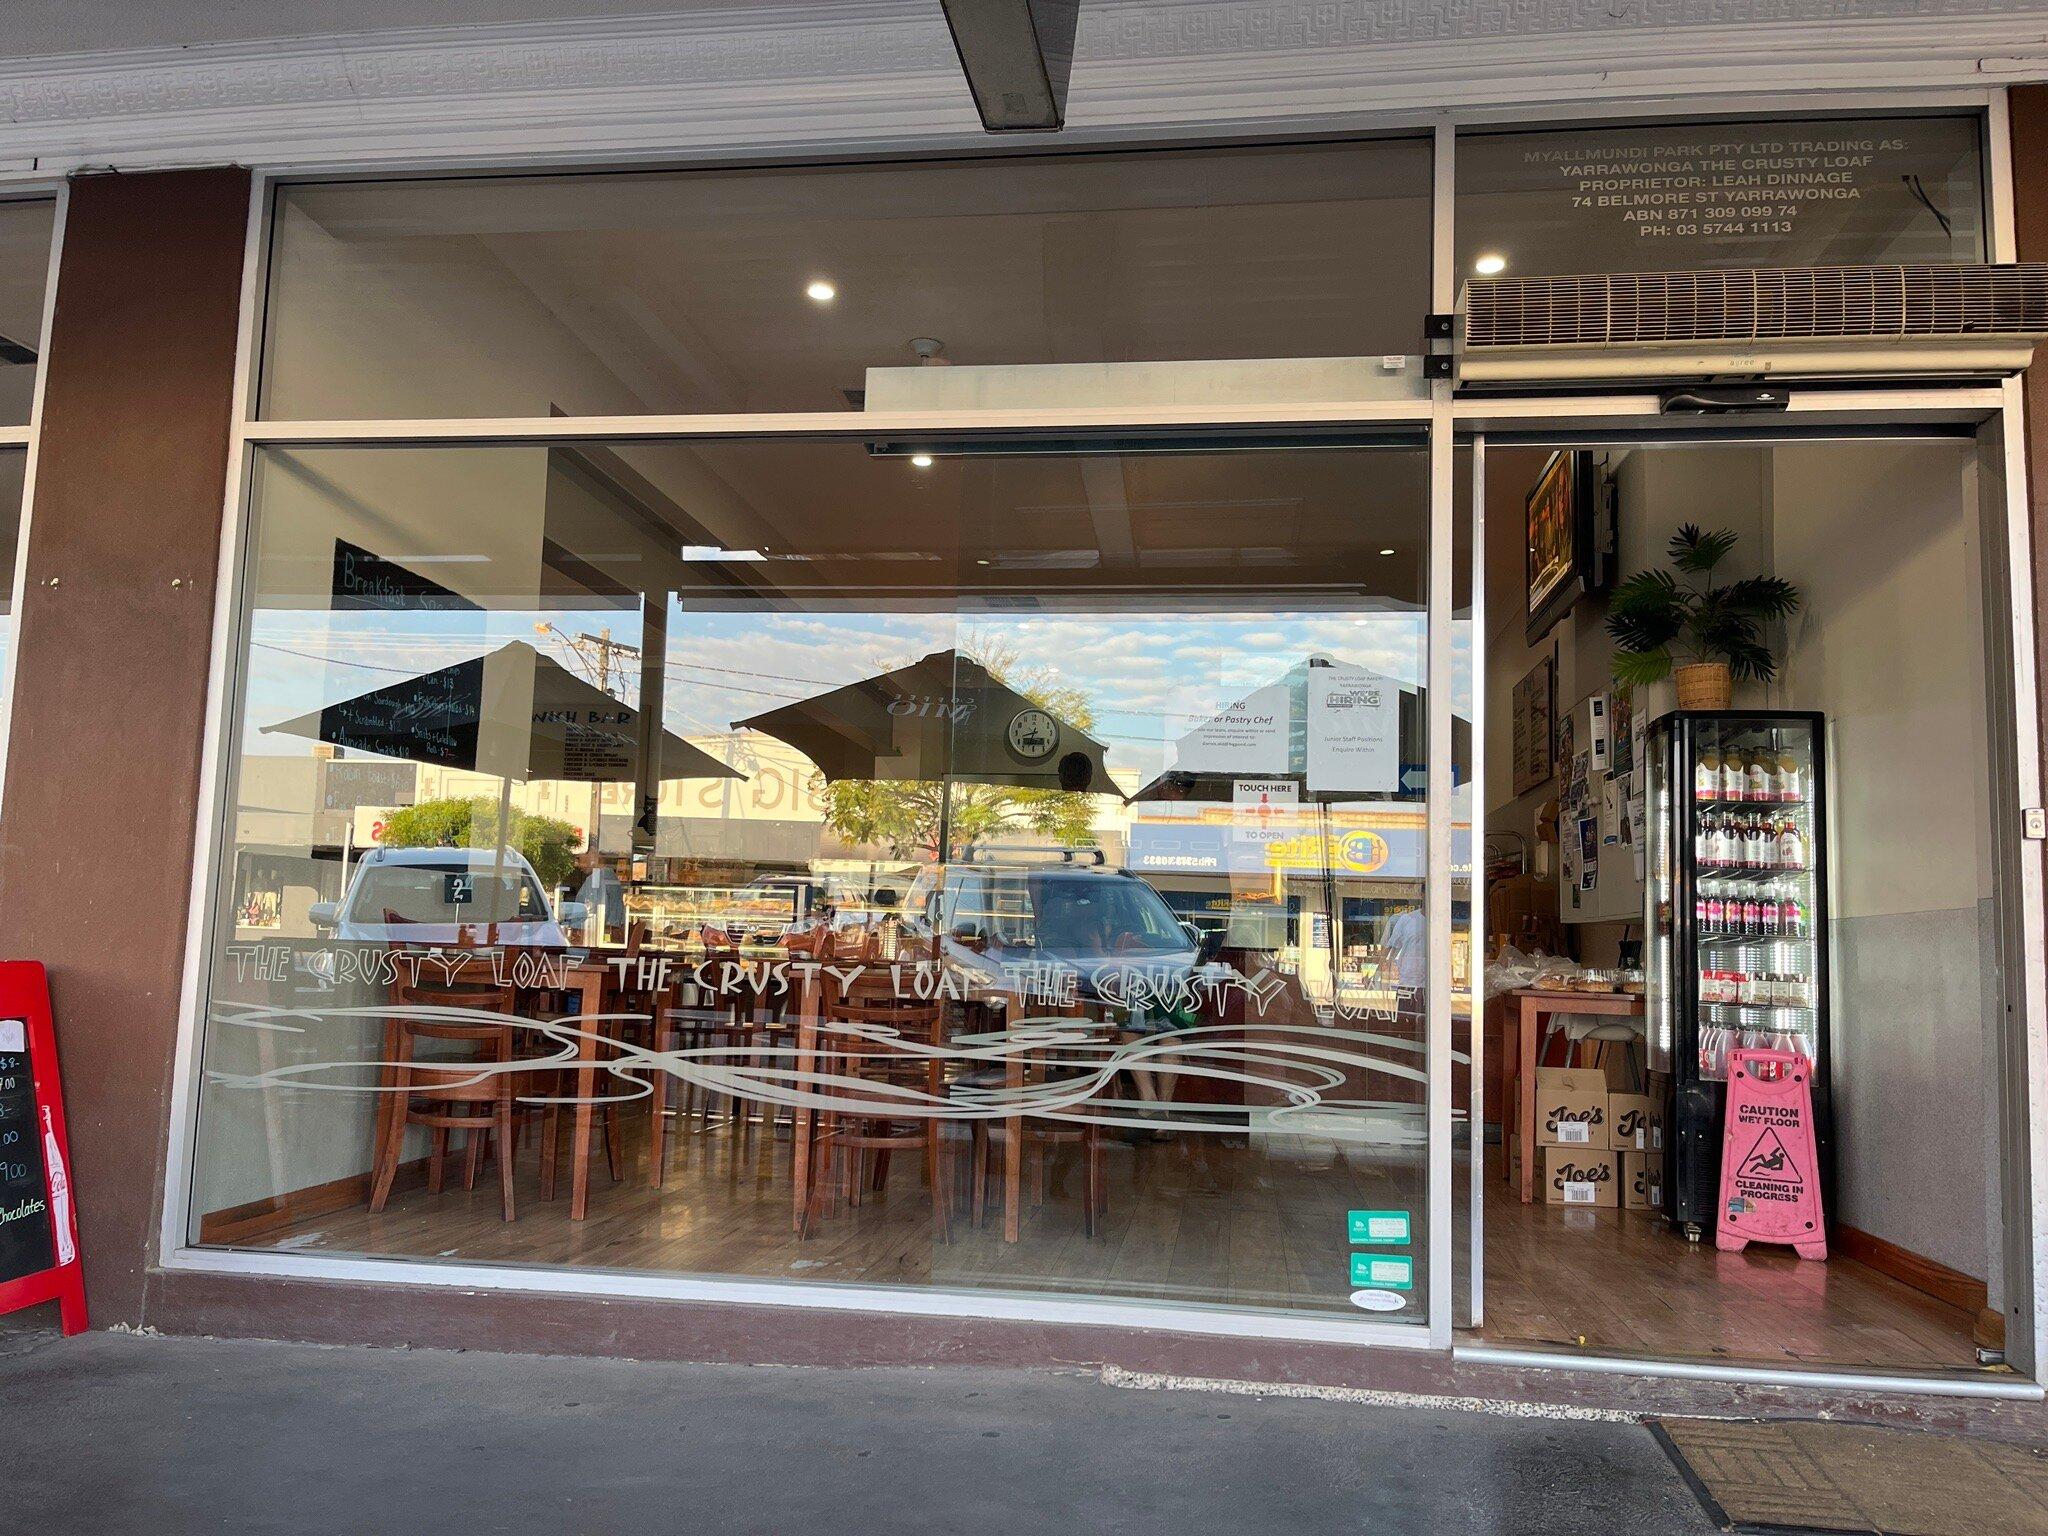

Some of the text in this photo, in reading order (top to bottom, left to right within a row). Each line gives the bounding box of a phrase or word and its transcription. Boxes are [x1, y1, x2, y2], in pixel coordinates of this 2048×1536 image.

[1524, 138, 1910, 163] MYALLMUNDI PARK PTY LTD TRADING AS:
[1558, 155, 1874, 177] YARRAWONGA THE CRUSTY LOAF
[1578, 171, 1854, 192] PROPRIETOR: LEAH DINNAGE
[1571, 187, 1861, 208] 74 BELMORE ST YARRAWONGA
[1622, 205, 1798, 222] ABN 871 309 099 74
[1640, 221, 1792, 237] PH: 03 5744 1113
[343, 551, 407, 607] Breakfast
[1215, 701, 1246, 711] HIRING
[1328, 696, 1379, 704] HIRING
[588, 711, 632, 724] BAR
[1224, 715, 1252, 726] Pastry
[1253, 715, 1274, 726] Chef
[1238, 784, 1292, 793] TOUCH HERE
[1245, 831, 1284, 841] TO OPEN
[226, 945, 586, 991] THE CRUSTY LOAF
[607, 957, 673, 992] THE
[693, 959, 867, 998] CRUSTY
[1004, 965, 1077, 1009] THE
[1099, 968, 1287, 1017] CRUSTY
[1545, 1105, 1604, 1133] Joe's
[1739, 1104, 1799, 1118] CAUTION
[1738, 1115, 1800, 1128] WET FLOOR
[1553, 1162, 1611, 1190] Joe's
[1735, 1180, 1804, 1194] CLEANING IN
[1740, 1189, 1799, 1203] PROGRESS
